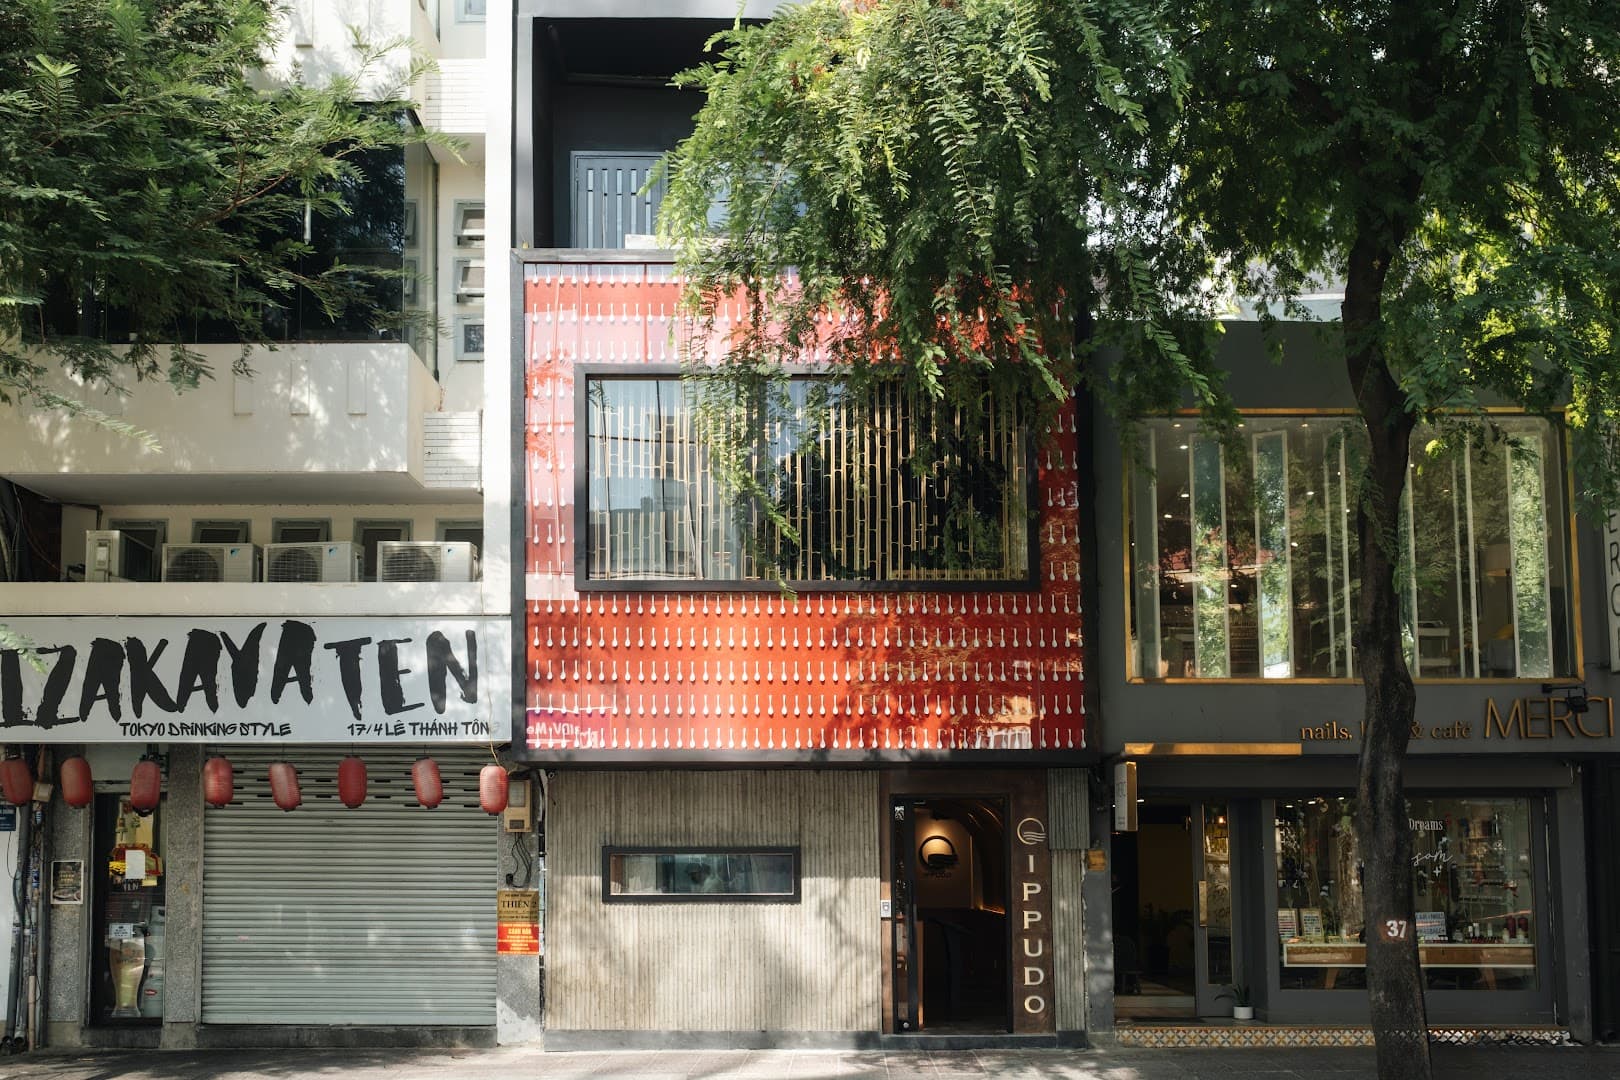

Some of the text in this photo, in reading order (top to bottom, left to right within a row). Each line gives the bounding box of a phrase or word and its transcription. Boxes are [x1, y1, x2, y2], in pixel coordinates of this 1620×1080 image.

[0, 619, 478, 730] IZAKAYA TEN
[1484, 696, 1614, 738] MERCI
[119, 722, 165, 737] TOKYO
[239, 722, 292, 737] STYLE
[347, 721, 383, 736] 17/4
[408, 719, 458, 736] THÁNH
[1410, 721, 1425, 738] &
[1408, 818, 1443, 831] Dreams
[1022, 854, 1046, 1014] IPPUDO
[1386, 919, 1408, 939] 37
